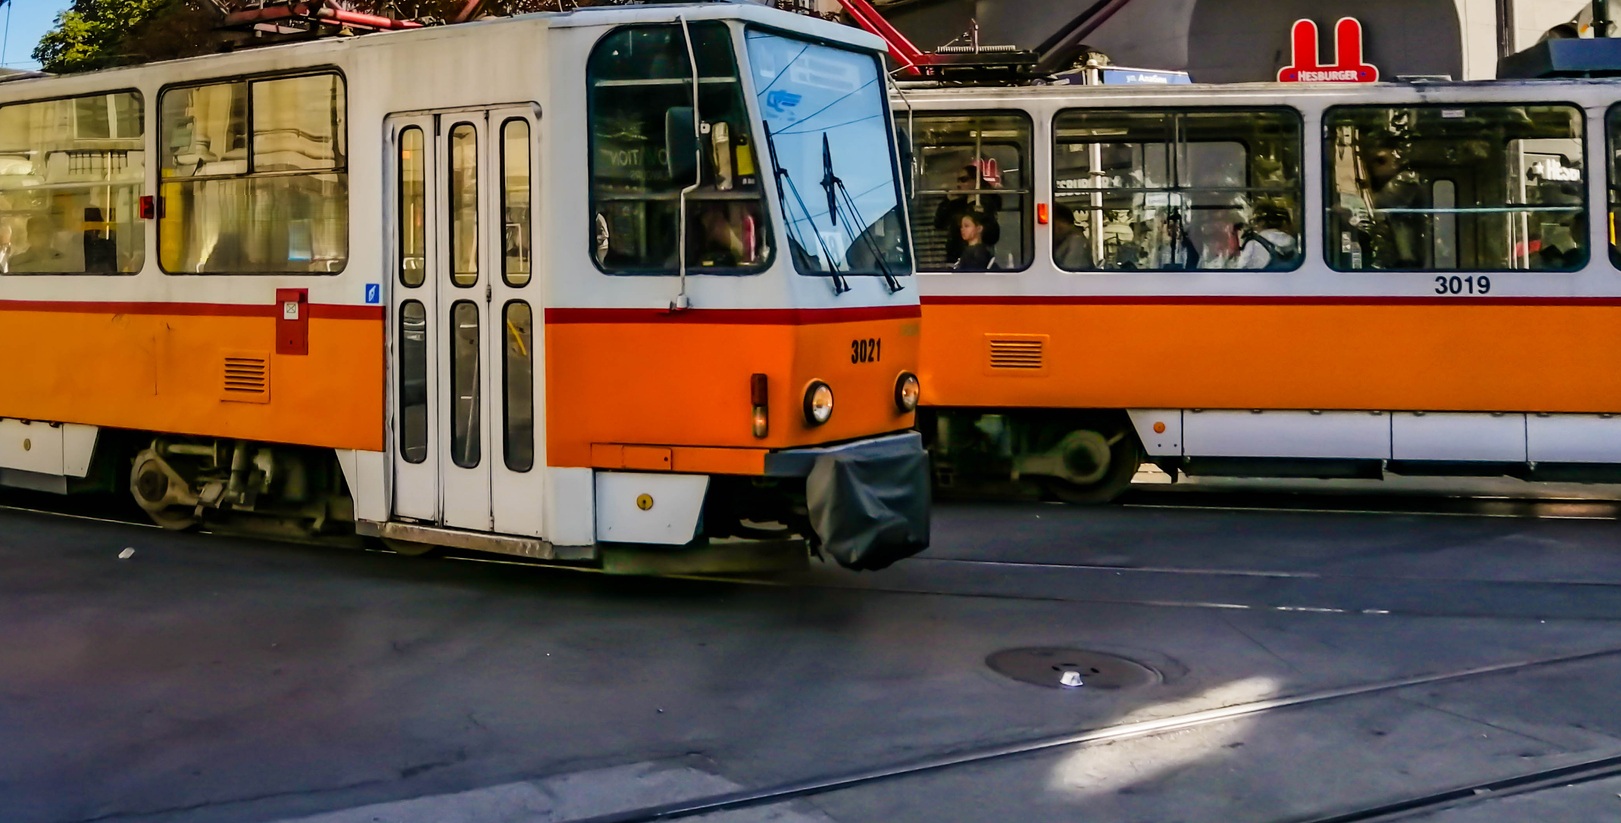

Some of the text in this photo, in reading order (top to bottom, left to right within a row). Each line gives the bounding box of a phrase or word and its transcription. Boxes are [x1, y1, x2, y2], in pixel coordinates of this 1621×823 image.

[1297, 70, 1359, 82] HESBURGER
[1435, 275, 1491, 294] 3019
[851, 337, 881, 364] 3021
